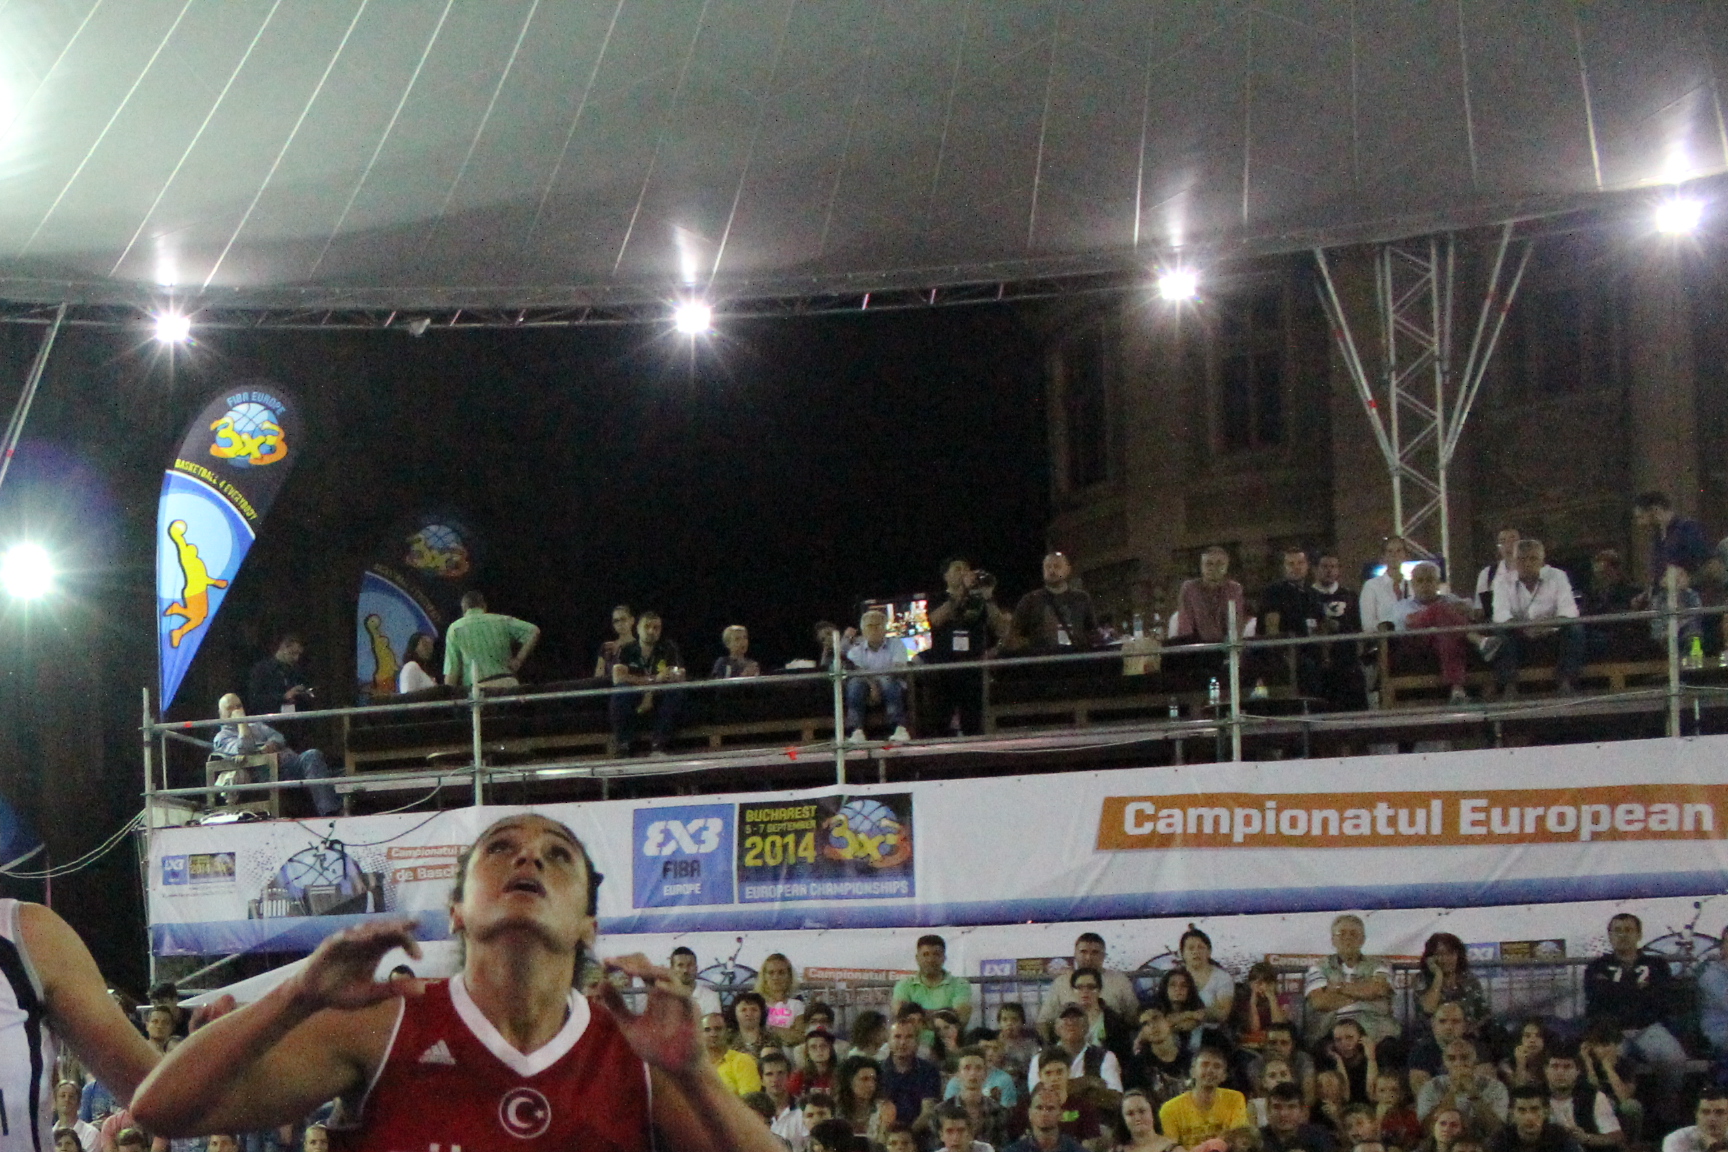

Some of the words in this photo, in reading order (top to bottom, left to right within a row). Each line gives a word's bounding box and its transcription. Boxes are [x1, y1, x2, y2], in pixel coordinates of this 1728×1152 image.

[251, 391, 286, 415] EUROPE
[174, 458, 218, 485] BASKETBALL
[745, 805, 818, 823] BUCHAREST
[1123, 799, 1444, 844] Campionatul
[1459, 797, 1715, 842] European
[767, 819, 817, 833] SEPTEMBER
[744, 831, 817, 868] 2014
[396, 868, 414, 881] de
[662, 859, 702, 880] FIBA
[662, 882, 702, 896] EUROPE
[745, 883, 807, 900] EUROPEAN
[809, 880, 909, 897] CHAMPIONSHIPS
